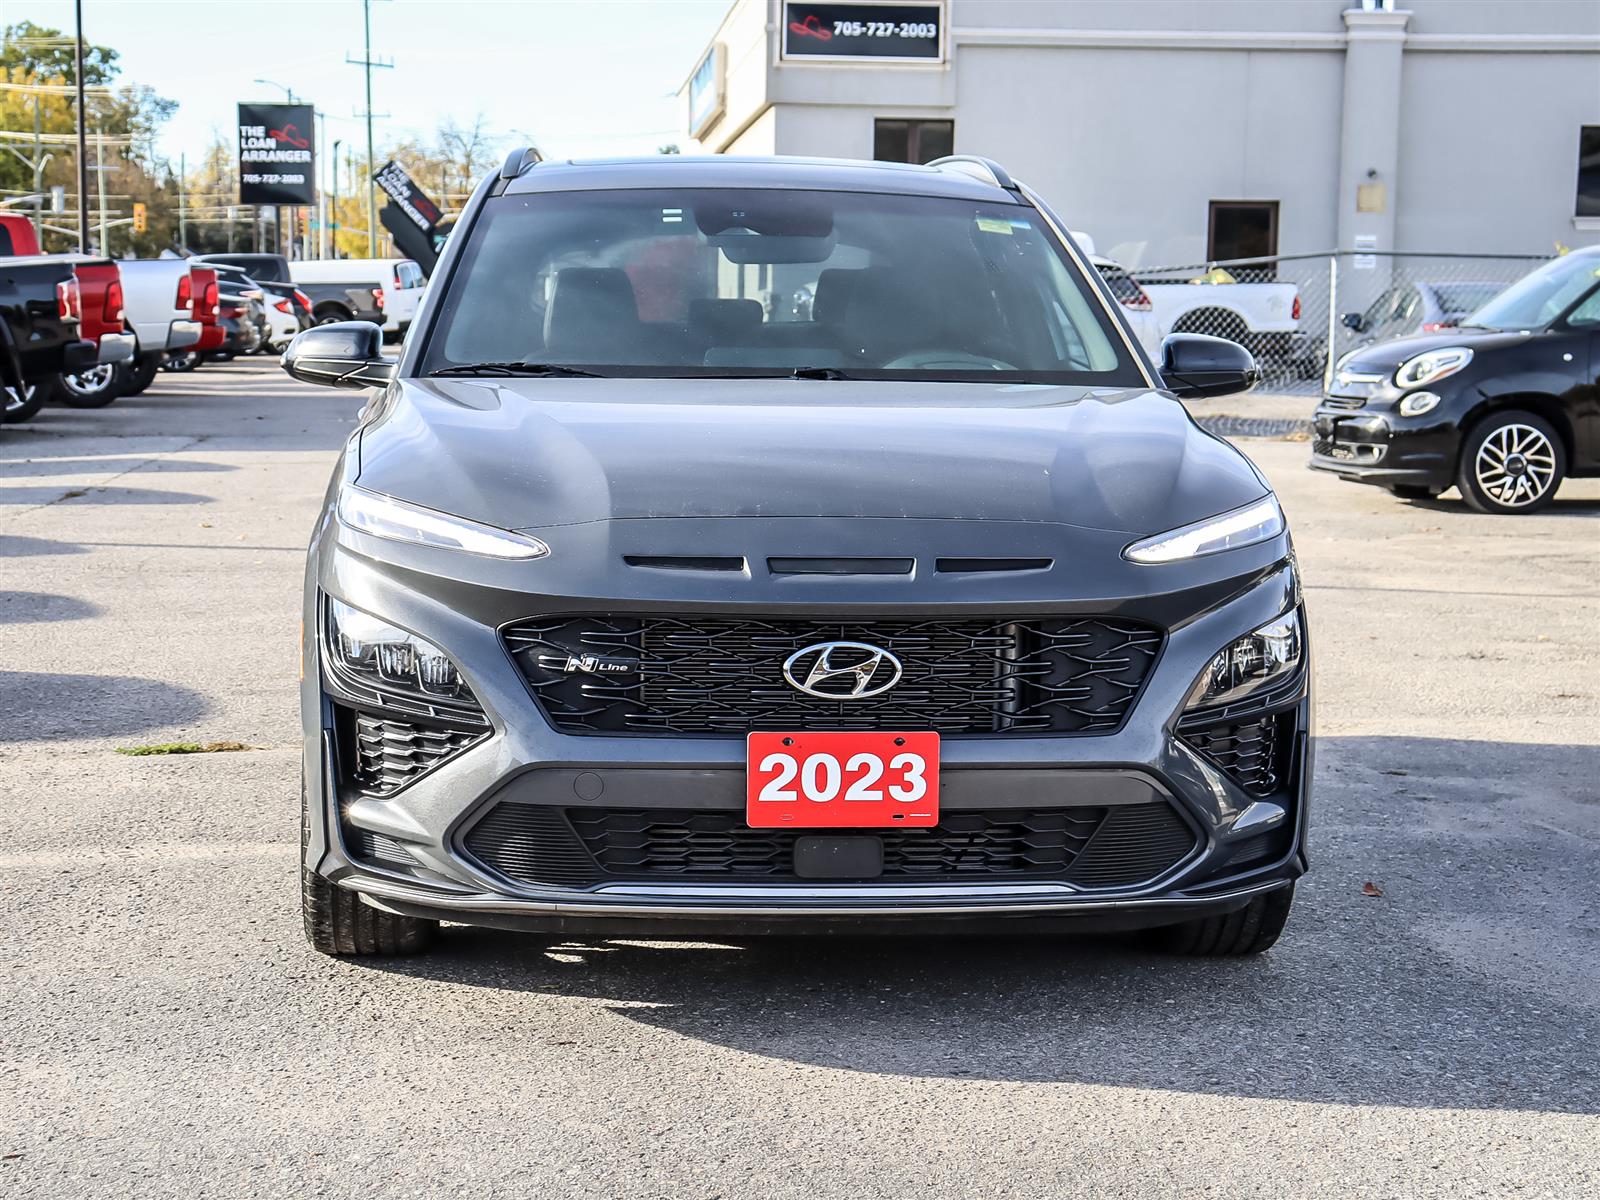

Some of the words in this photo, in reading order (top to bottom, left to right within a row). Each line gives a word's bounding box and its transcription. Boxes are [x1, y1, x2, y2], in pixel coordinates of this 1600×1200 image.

[834, 20, 937, 39] 705-727-2003
[240, 125, 266, 137] THE
[241, 137, 277, 150] LOAN
[241, 150, 312, 163] ARRANGER
[382, 168, 412, 198] LOAN
[390, 165, 410, 184] THE
[376, 176, 430, 231] ARRANGER
[565, 656, 599, 673] N
[598, 663, 629, 672] Line
[758, 752, 928, 803] 2023
